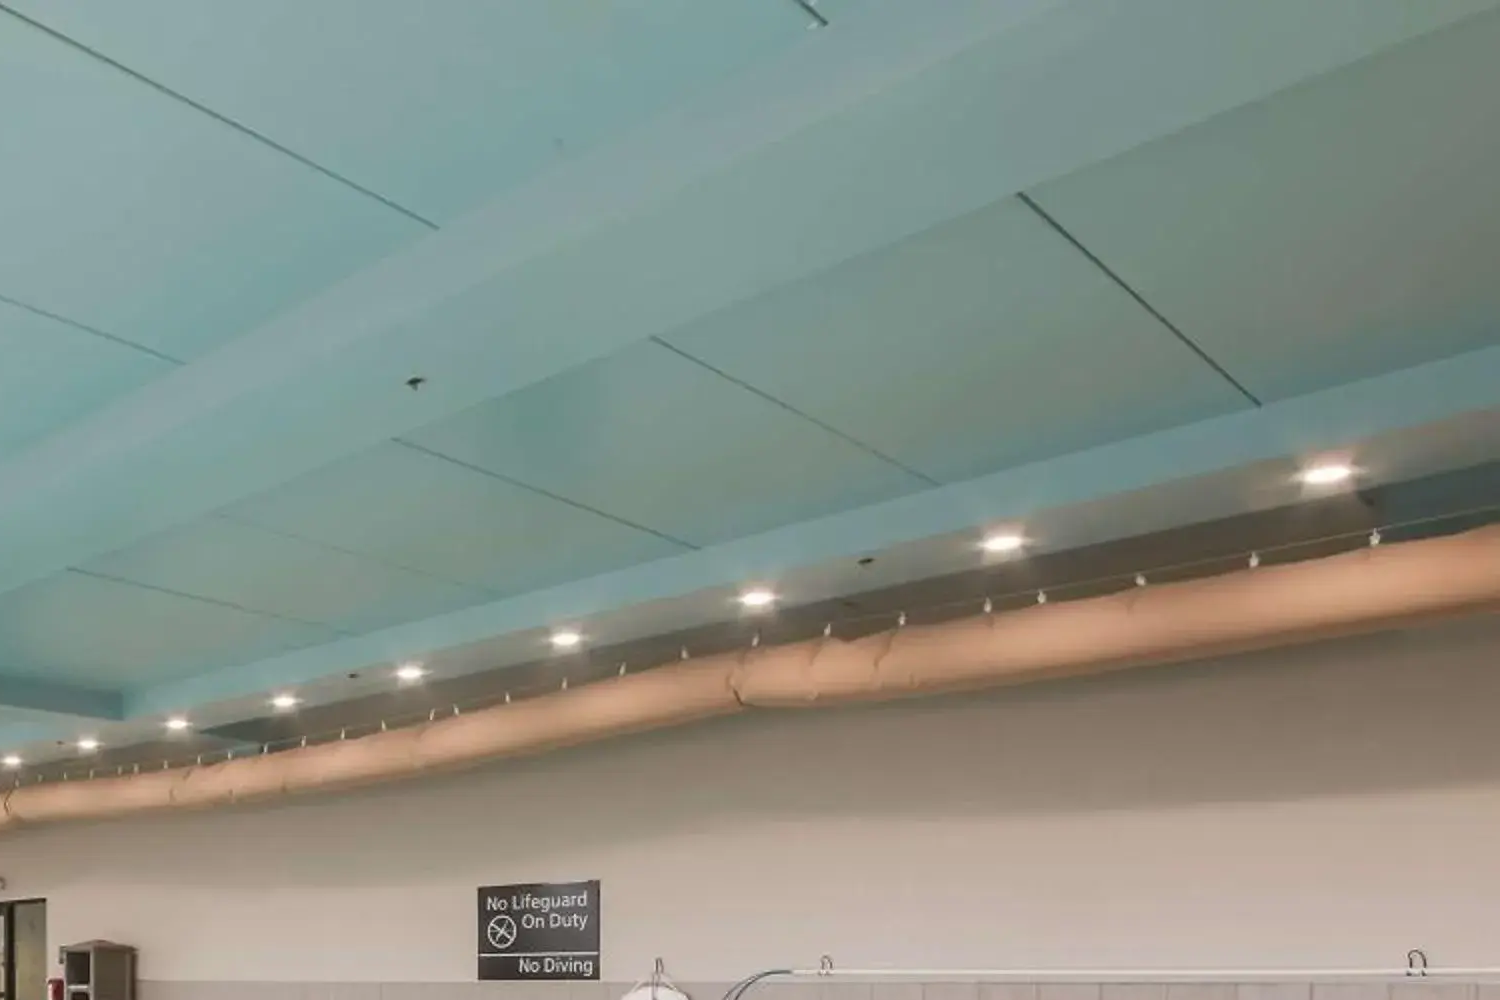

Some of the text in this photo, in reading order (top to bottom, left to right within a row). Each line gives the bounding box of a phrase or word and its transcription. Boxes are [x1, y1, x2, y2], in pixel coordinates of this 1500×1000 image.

[486, 890, 588, 913] No Lifeguard
[521, 913, 588, 931] On Duty
[518, 957, 593, 977] No Diving
